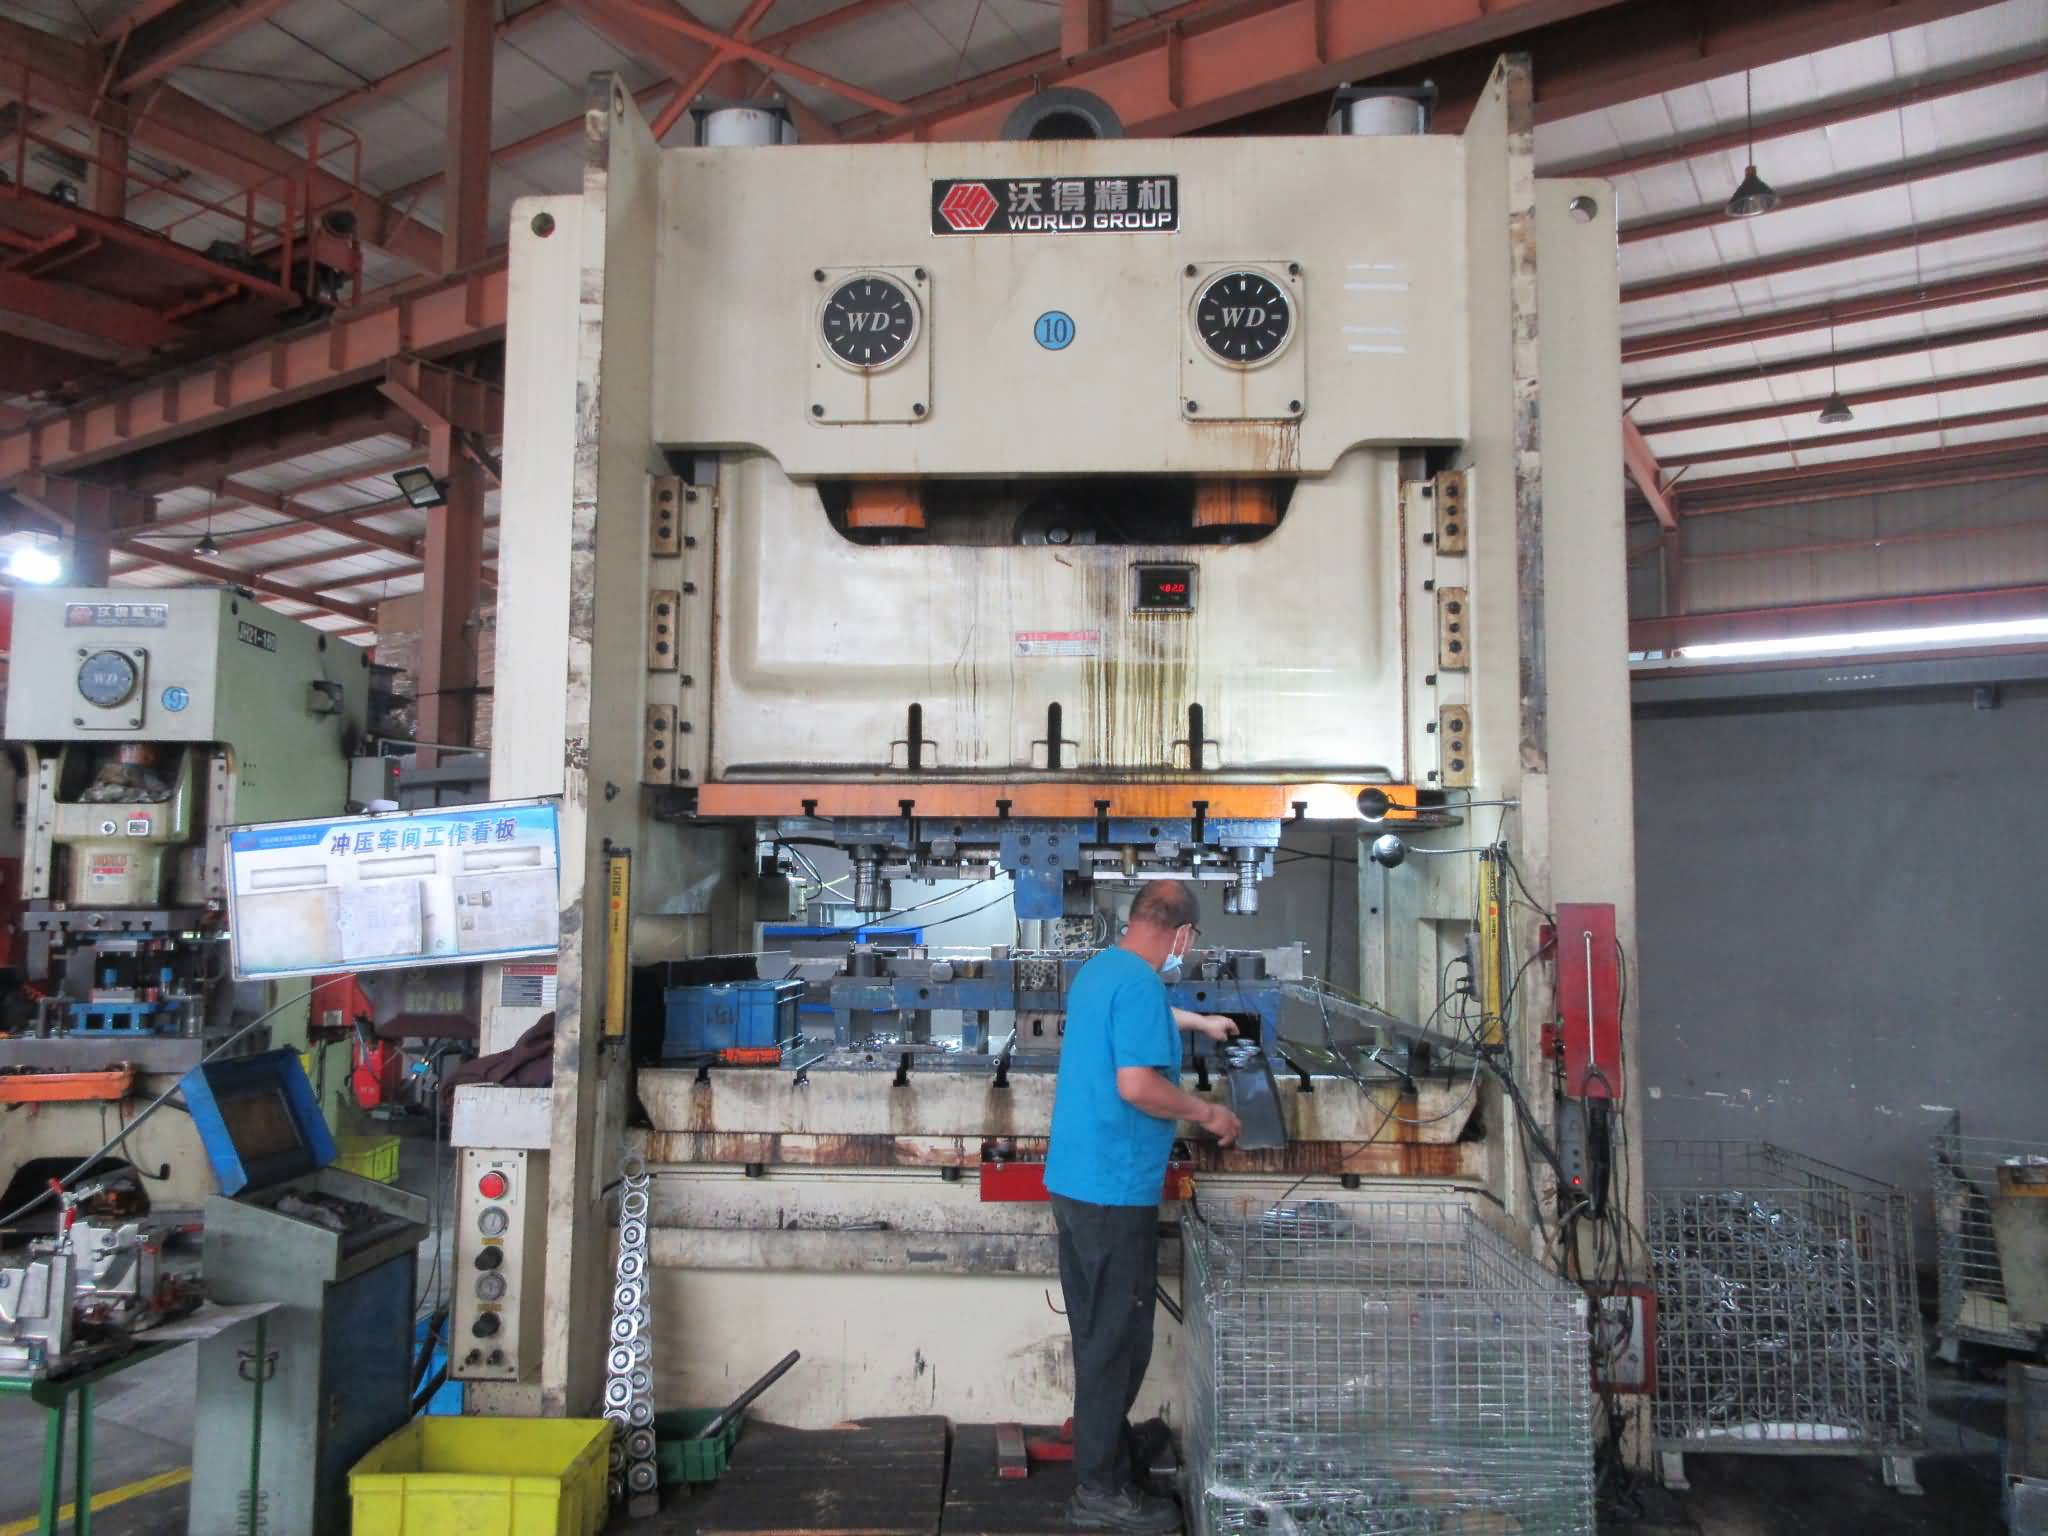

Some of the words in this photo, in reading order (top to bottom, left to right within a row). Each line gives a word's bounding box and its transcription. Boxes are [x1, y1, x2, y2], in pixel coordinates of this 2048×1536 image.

[1008, 180, 1172, 212] 沃得精机
[1008, 214, 1087, 230] WORLD
[1093, 212, 1172, 229] GROUP
[847, 312, 890, 332] WD
[1222, 307, 1266, 328] WD
[1043, 318, 1067, 343] 10
[330, 817, 517, 856] 冲压车间工作看板
